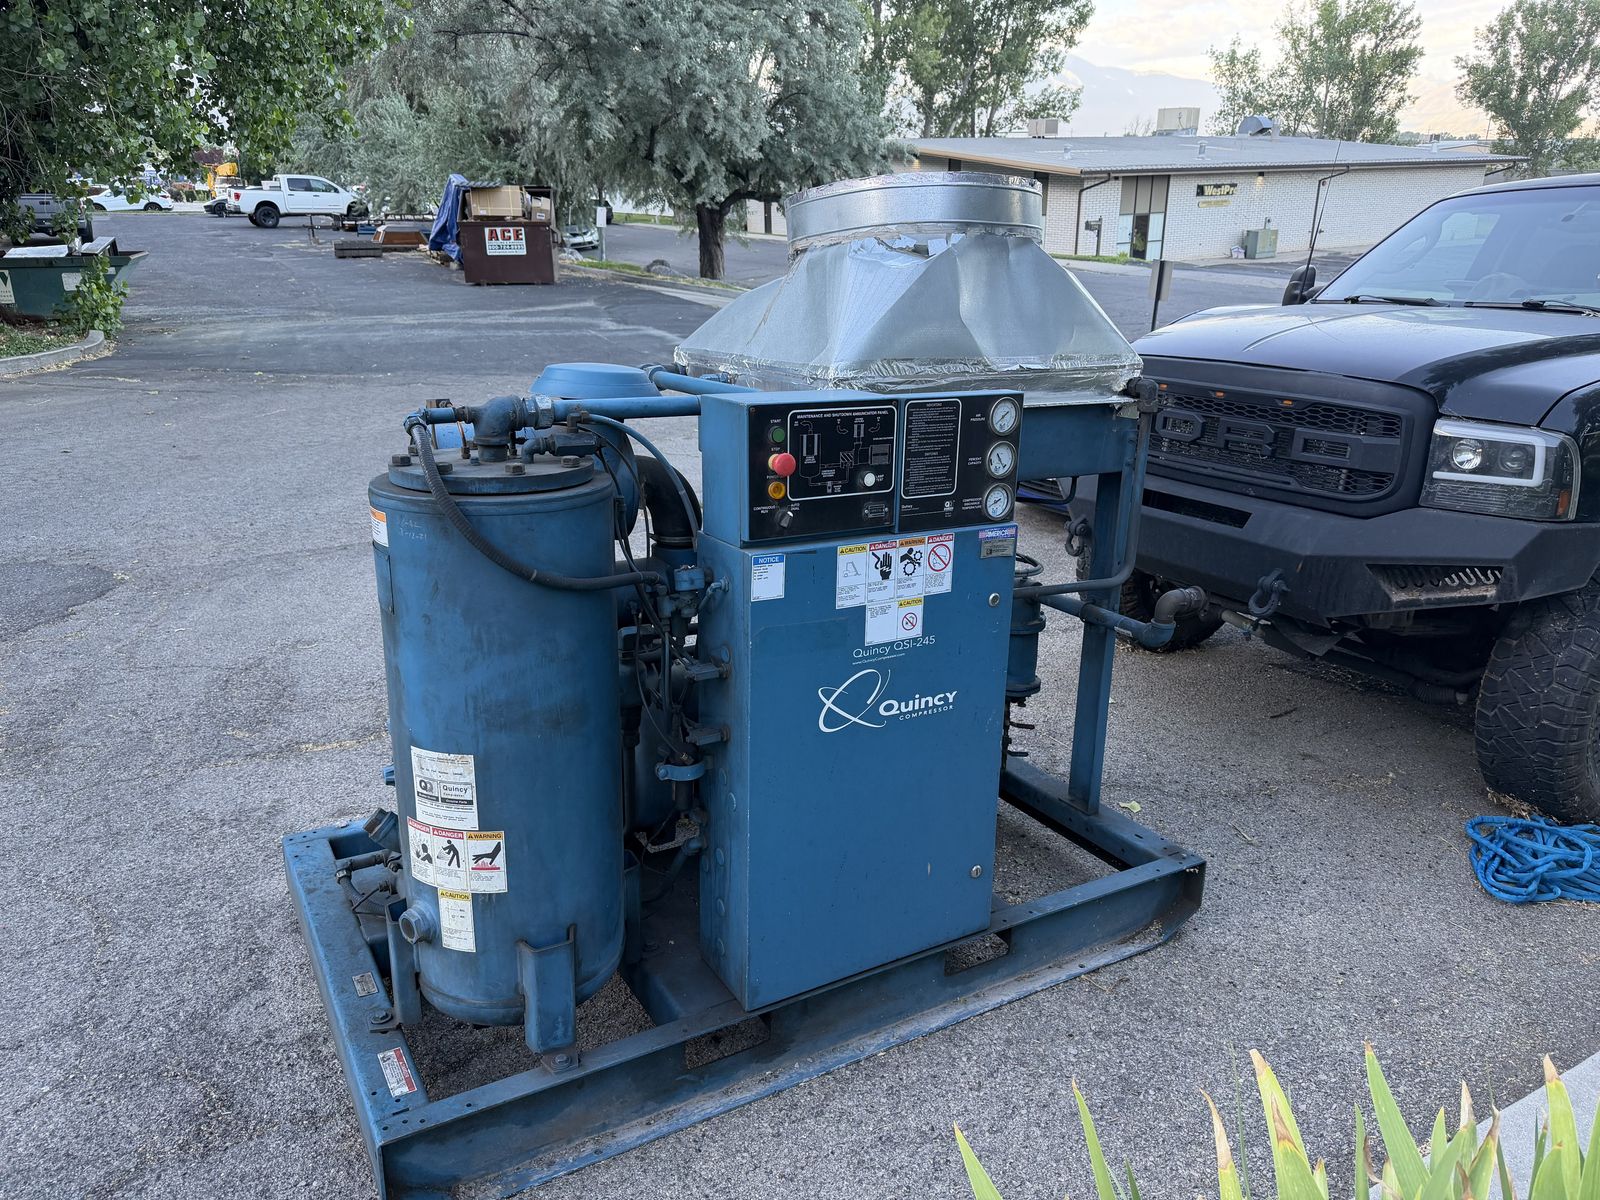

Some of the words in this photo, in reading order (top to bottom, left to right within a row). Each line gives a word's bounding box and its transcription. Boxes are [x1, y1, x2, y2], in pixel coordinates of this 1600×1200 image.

[488, 228, 523, 241] ACE
[904, 538, 926, 546] WARNING
[931, 534, 953, 542] DANGER
[844, 545, 867, 554] CAUTION
[875, 541, 897, 550] DANGER
[758, 556, 780, 564] NOTICE
[902, 598, 922, 607] CAUTION
[853, 644, 891, 658] Quincy
[894, 636, 936, 651] QSI-245
[879, 691, 958, 717] Quincy
[899, 705, 954, 721] COMPRESSOR
[442, 784, 469, 794] Quincy
[413, 820, 430, 833] DANGER
[438, 829, 464, 839] DANGER
[445, 892, 470, 900] CAUTION
